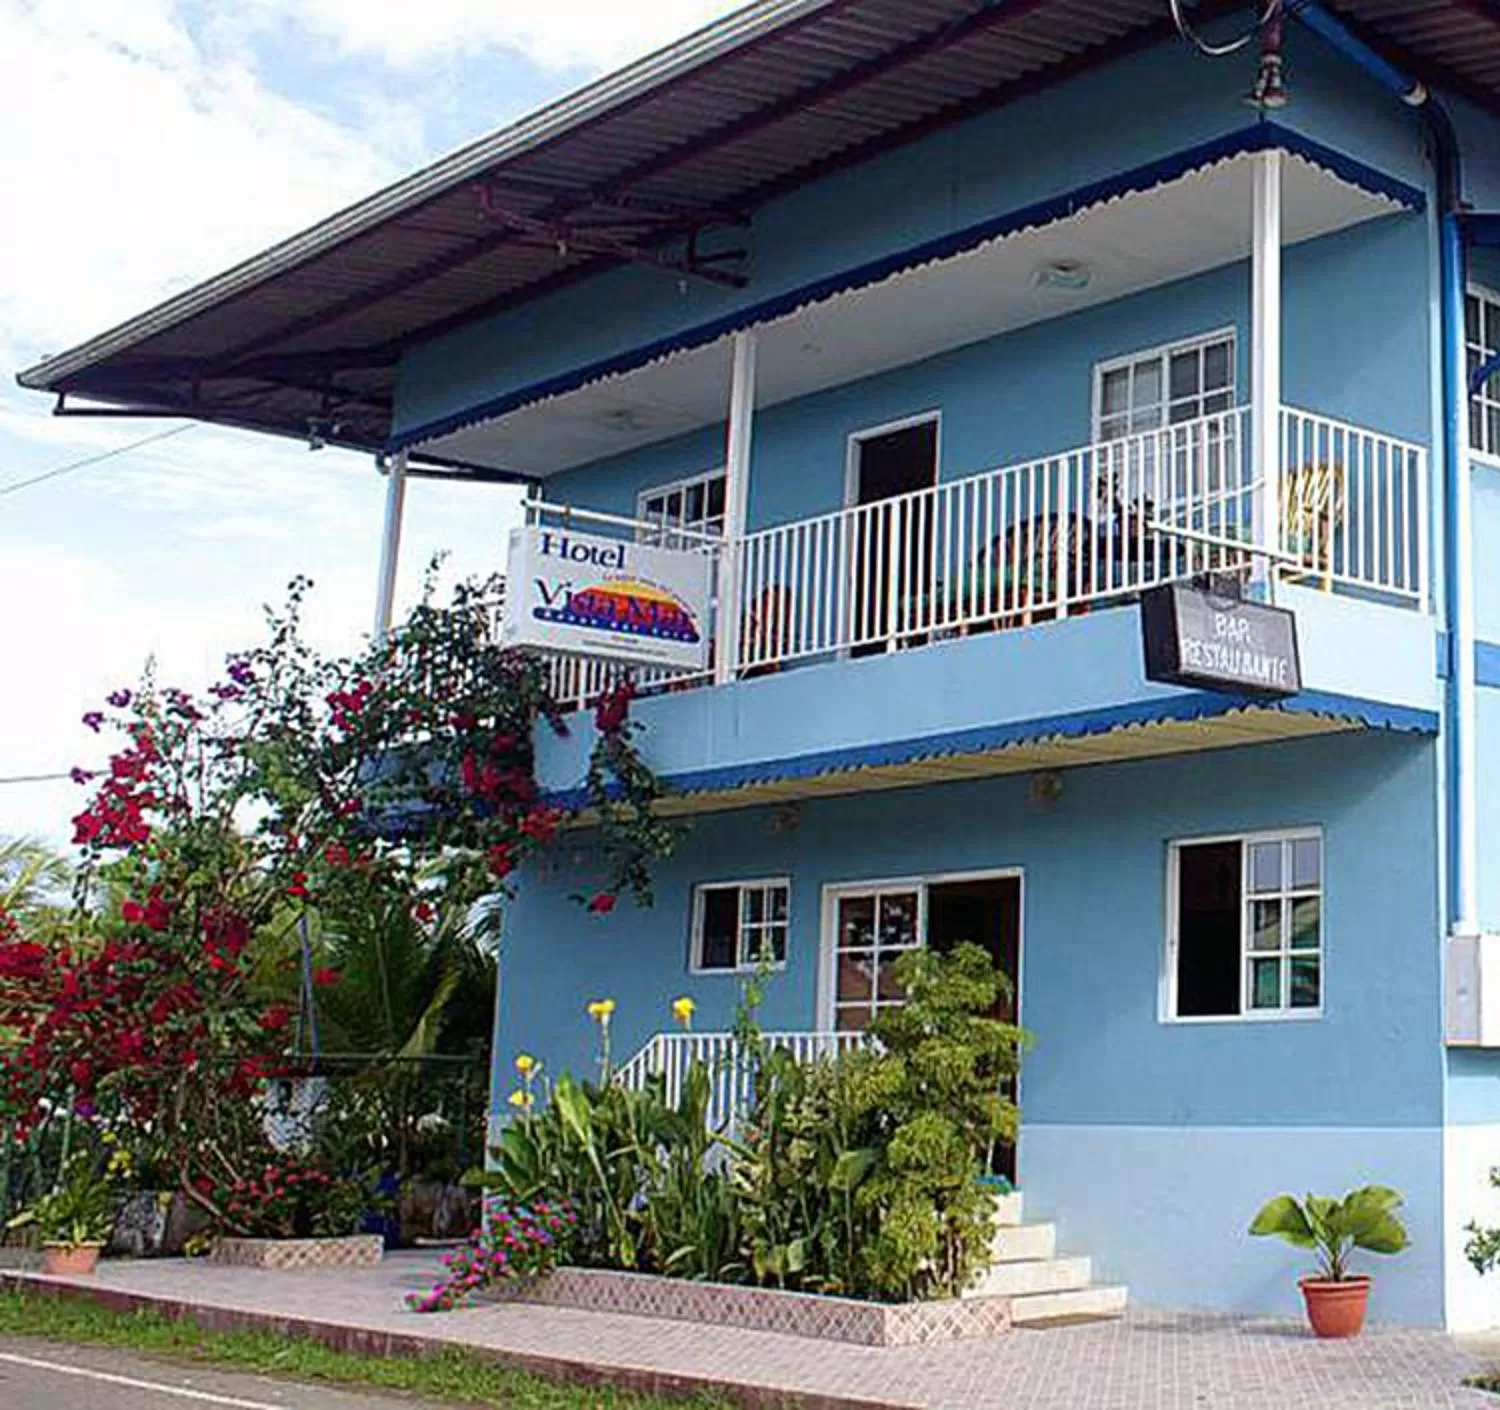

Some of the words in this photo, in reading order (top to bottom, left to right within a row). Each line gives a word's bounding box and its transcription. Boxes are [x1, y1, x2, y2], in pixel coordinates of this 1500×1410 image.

[541, 532, 625, 569] Hotel
[1215, 612, 1251, 642] BAR
[1182, 637, 1288, 684] RESTAURANTE
